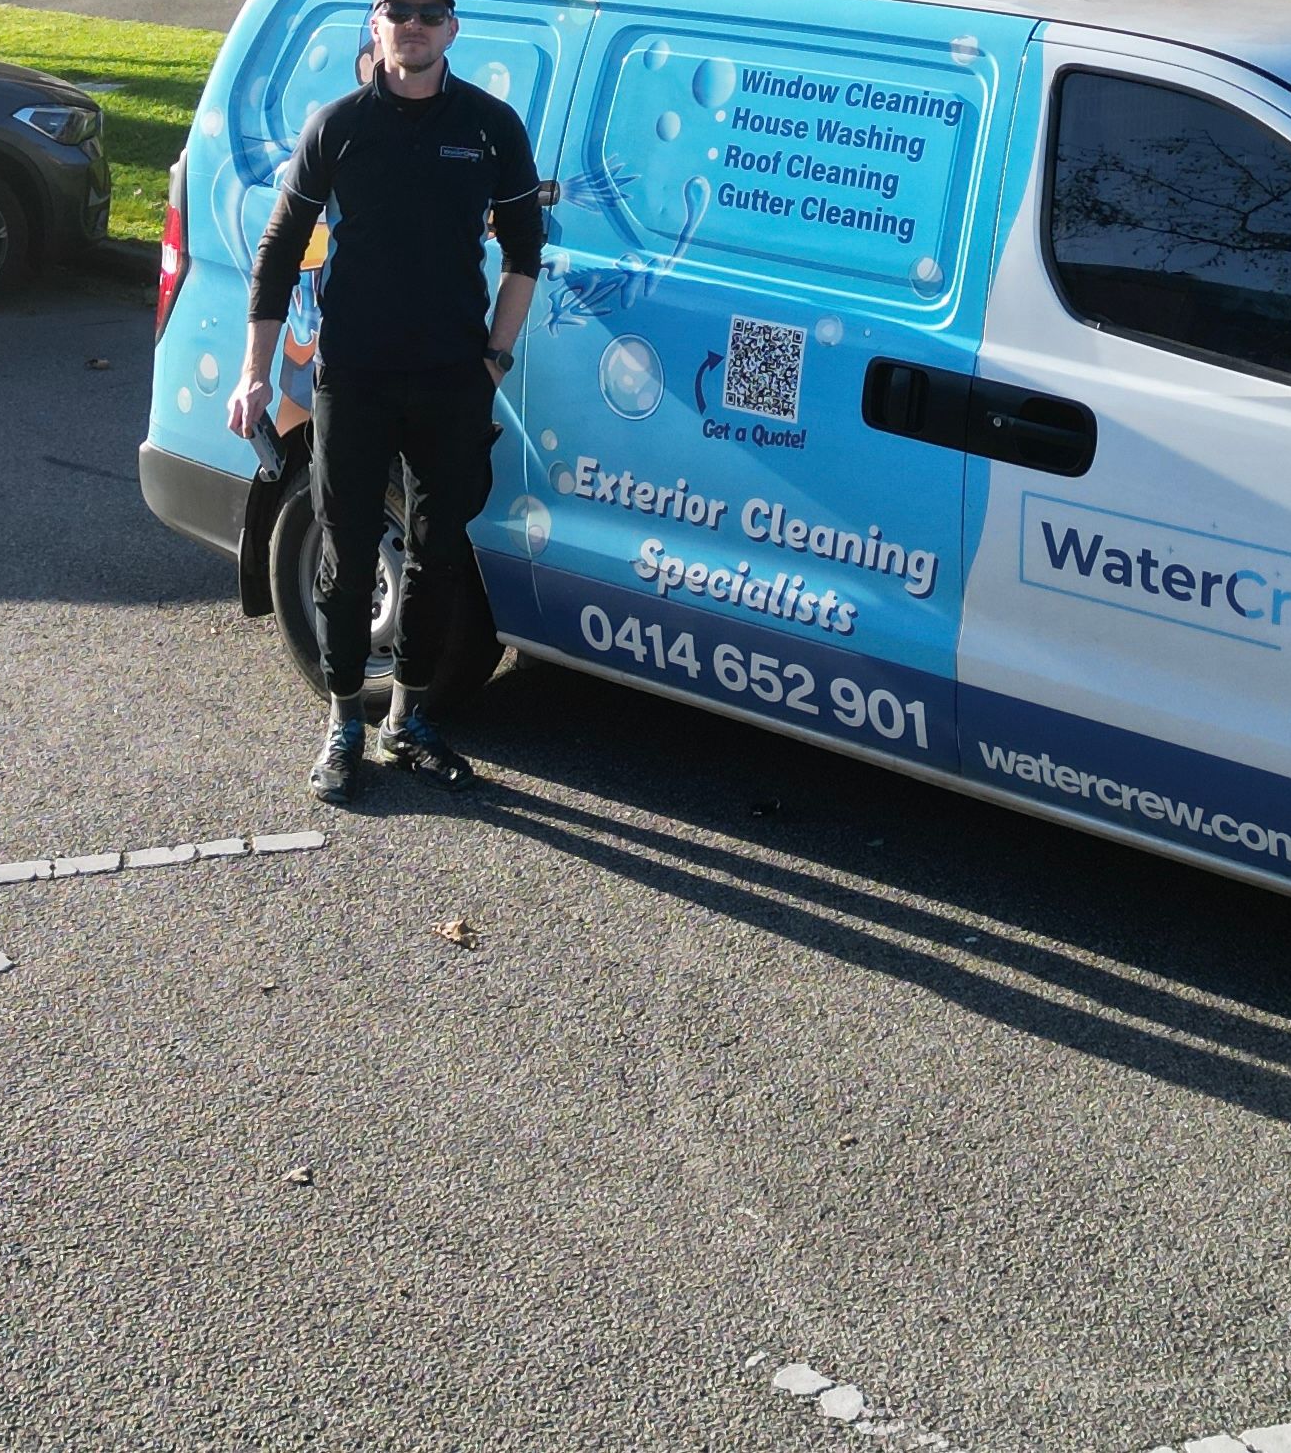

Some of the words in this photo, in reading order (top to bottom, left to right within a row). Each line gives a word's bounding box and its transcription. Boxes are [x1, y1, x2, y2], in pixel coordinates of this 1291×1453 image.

[741, 68, 840, 104] Window
[845, 83, 965, 126] Cleaning
[731, 107, 809, 139] House
[816, 118, 926, 162] Washing
[724, 144, 783, 175] Roof
[786, 154, 900, 199] Cleaning
[717, 182, 795, 216] Gutter
[801, 196, 916, 244] Cleaning
[702, 418, 731, 441] Get
[735, 427, 747, 442] a
[752, 424, 807, 449] Quote!
[573, 455, 728, 531] Exterior
[741, 497, 939, 599] Cleaning
[634, 538, 859, 636] Specialists
[580, 604, 701, 679] 0414
[713, 643, 819, 715] 652
[829, 677, 929, 750] 901
